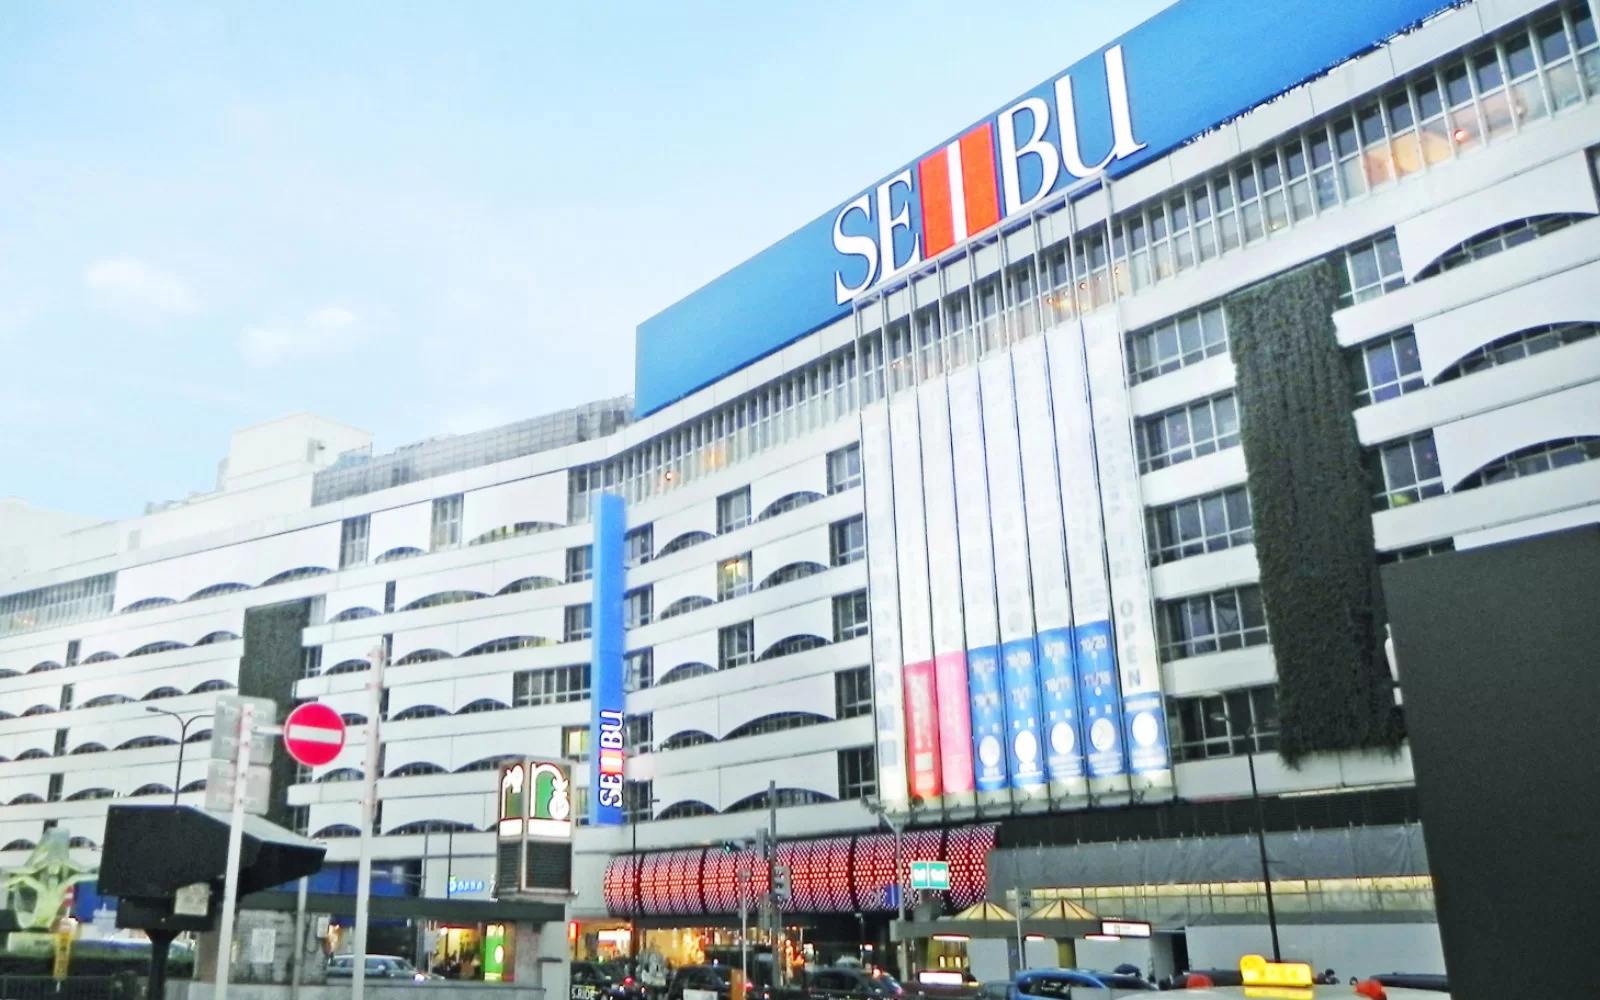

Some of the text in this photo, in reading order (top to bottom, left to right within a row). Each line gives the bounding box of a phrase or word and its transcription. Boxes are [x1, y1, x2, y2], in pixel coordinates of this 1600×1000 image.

[832, 44, 1148, 305] SEIBU
[1120, 600, 1142, 688] OPEN
[600, 709, 624, 808] SEIBU
